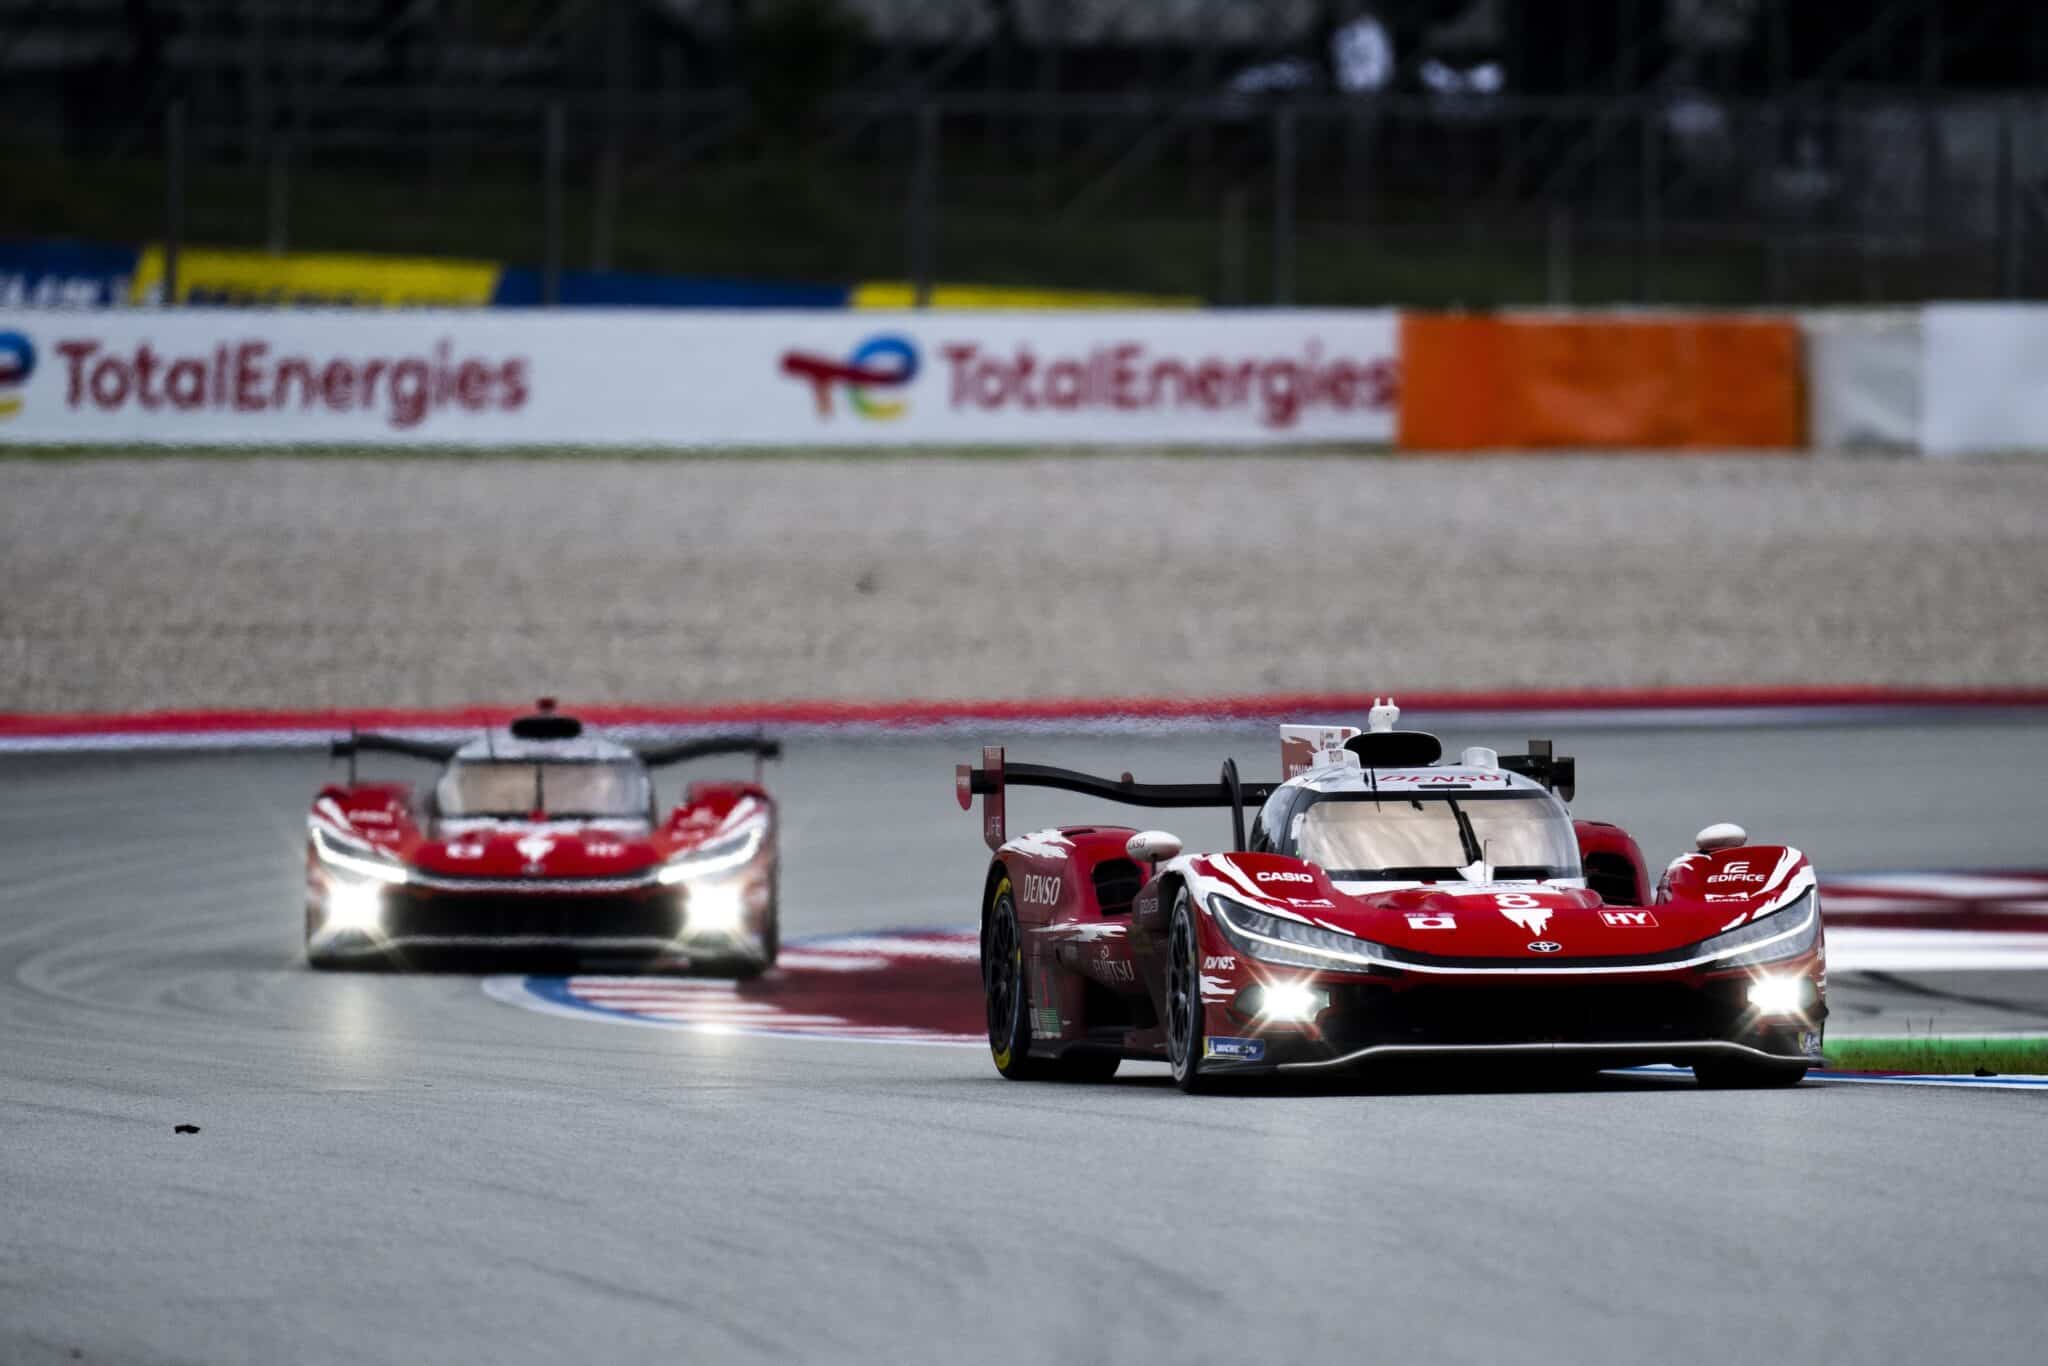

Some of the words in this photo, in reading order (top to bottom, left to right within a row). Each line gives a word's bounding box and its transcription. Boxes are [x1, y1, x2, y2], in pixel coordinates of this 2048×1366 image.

[56, 332, 530, 428] TotalEnergies
[1256, 872, 1313, 883] CASIO
[1707, 873, 1766, 883] EDIFICE
[1024, 874, 1060, 905] DENSO
[1603, 912, 1647, 925] HY
